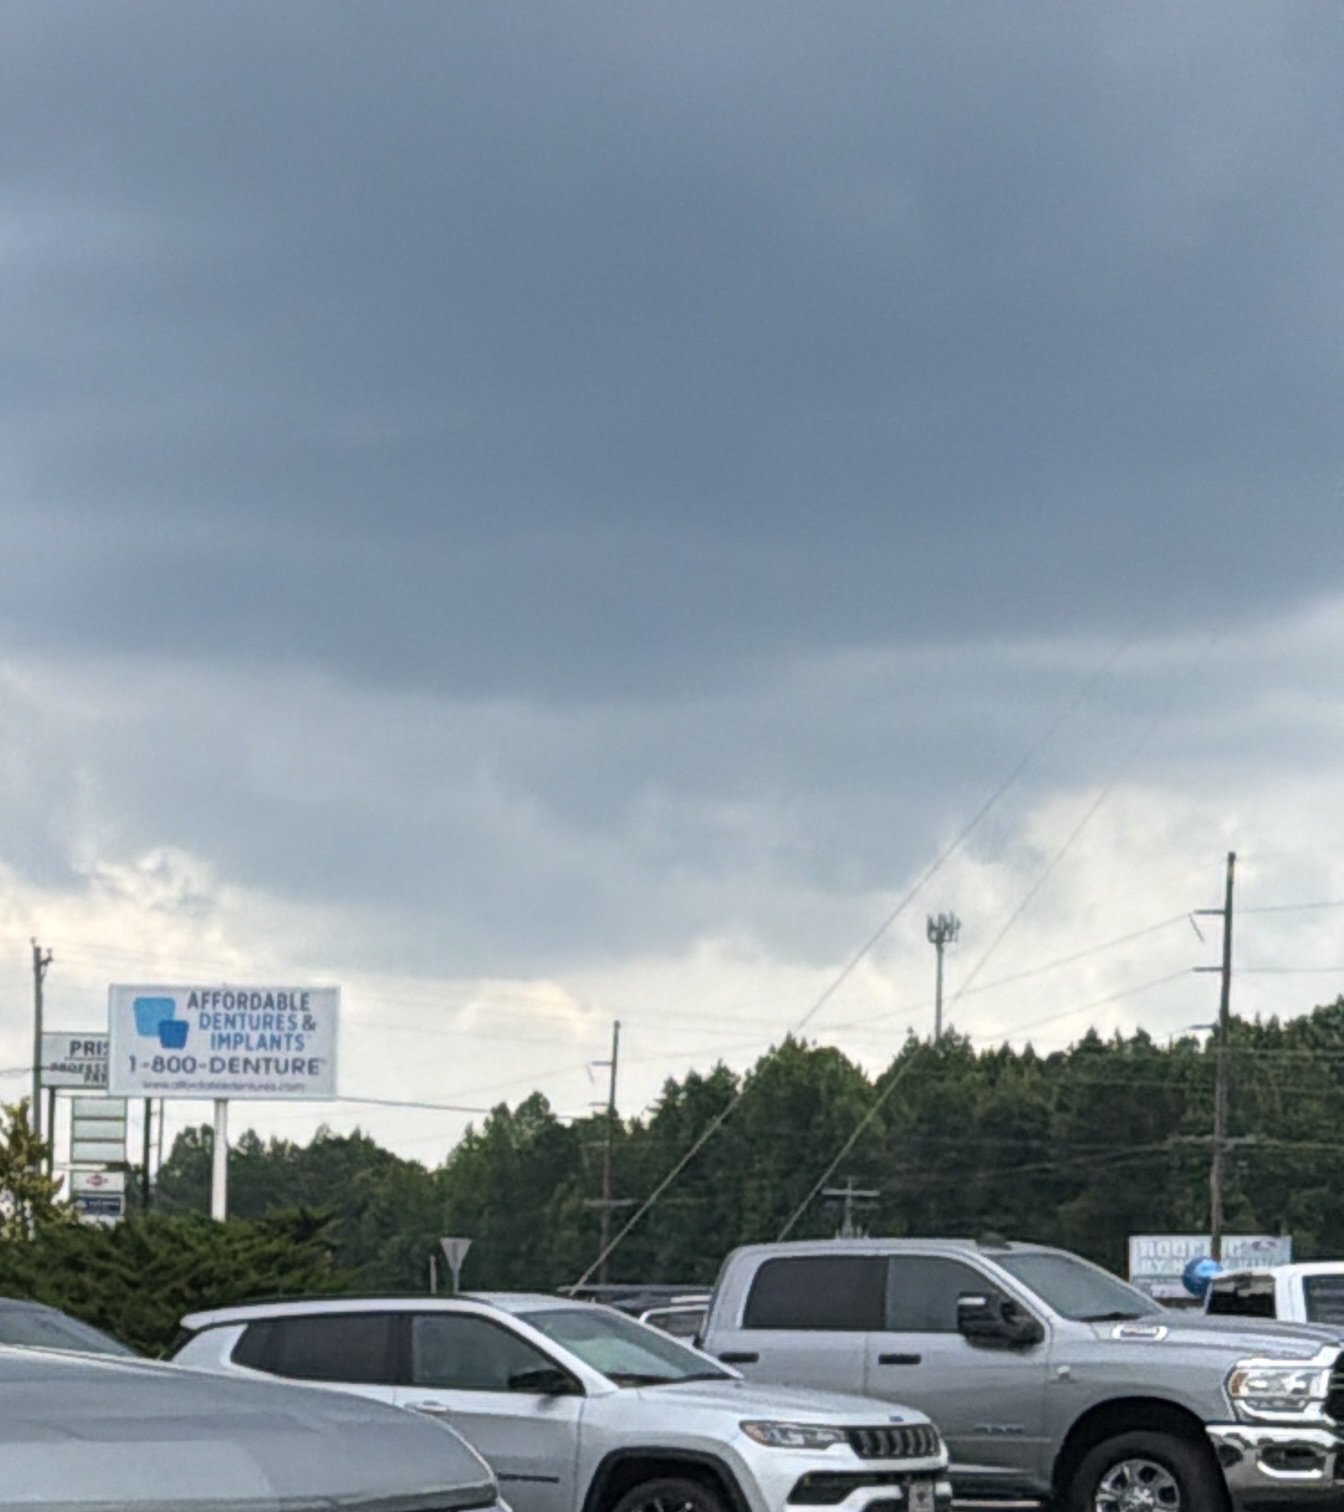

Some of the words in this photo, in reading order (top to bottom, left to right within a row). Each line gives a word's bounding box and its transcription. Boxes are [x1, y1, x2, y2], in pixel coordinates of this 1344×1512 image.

[187, 992, 311, 1013] AFFORDABLE
[199, 1012, 297, 1031] DENTURES
[301, 1015, 316, 1031] &
[210, 1032, 305, 1051] IMPLANTS
[128, 1055, 321, 1076] 1-800-DENTURE
